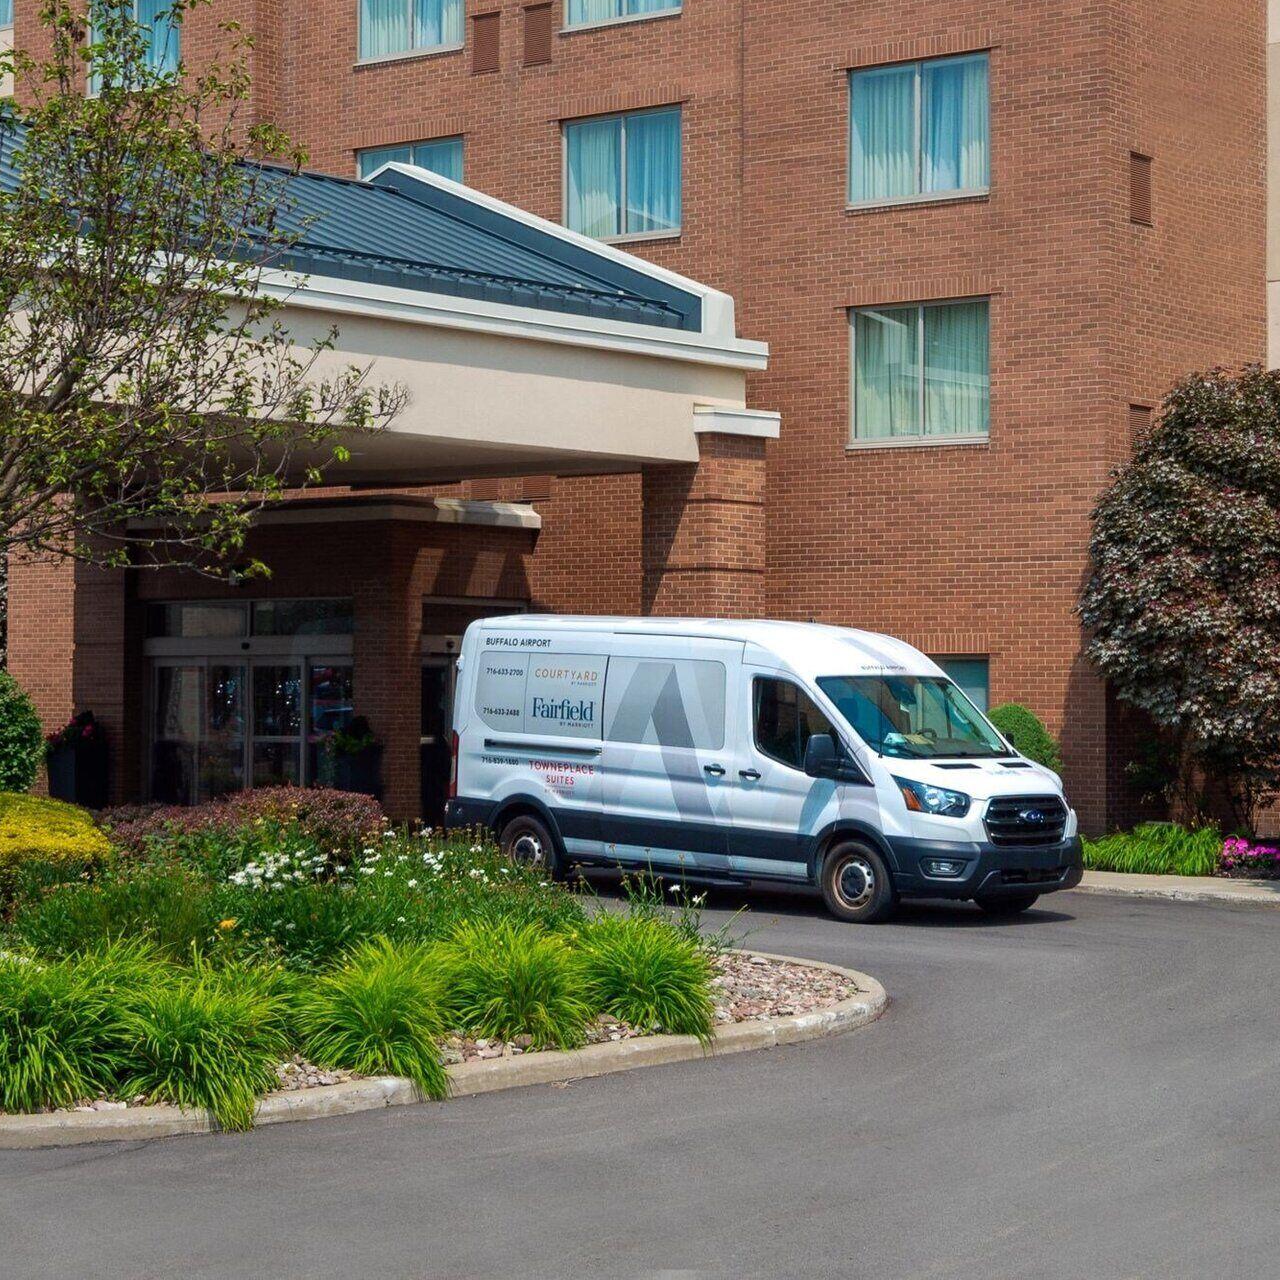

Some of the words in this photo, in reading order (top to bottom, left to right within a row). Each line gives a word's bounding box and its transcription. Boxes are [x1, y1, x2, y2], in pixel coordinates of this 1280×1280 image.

[485, 637, 518, 647] BUFFALO
[519, 638, 552, 648] AIRPORT
[534, 668, 599, 682] COURTYARD
[532, 696, 595, 722] Fairfield
[527, 759, 595, 775] TOWNEPLACE
[546, 775, 575, 786] SUITES
